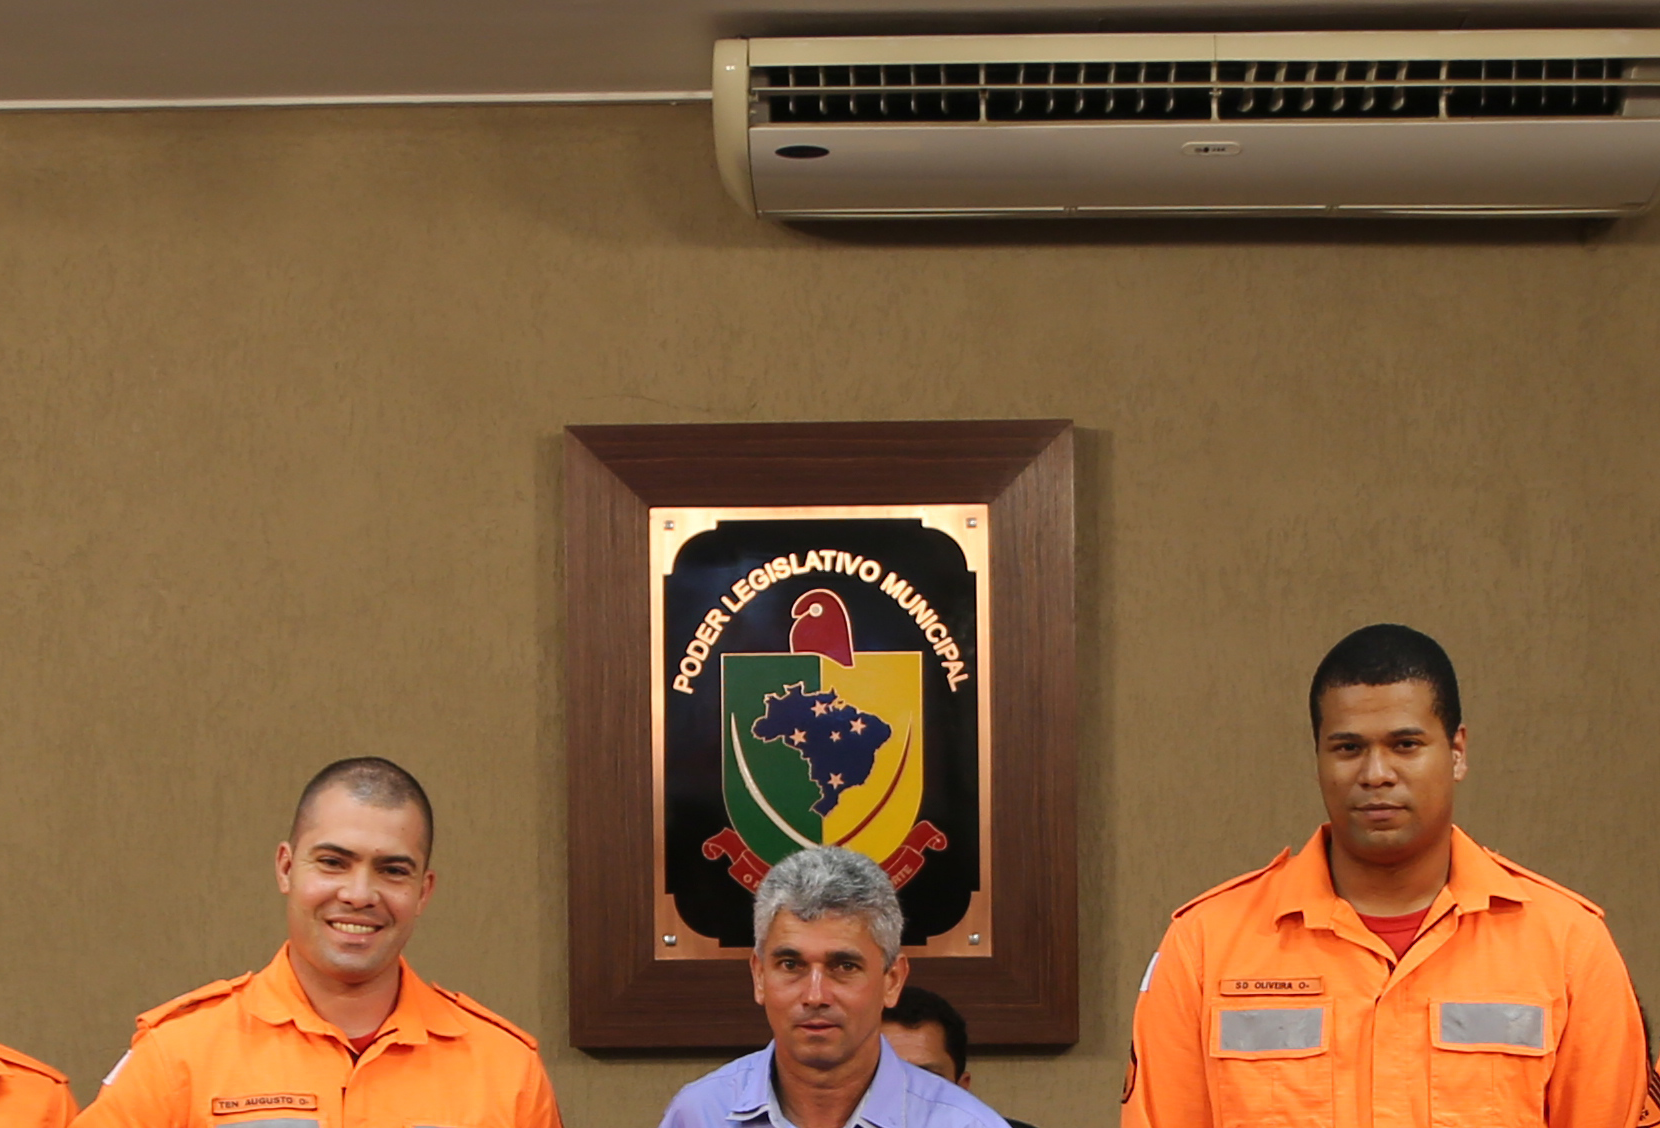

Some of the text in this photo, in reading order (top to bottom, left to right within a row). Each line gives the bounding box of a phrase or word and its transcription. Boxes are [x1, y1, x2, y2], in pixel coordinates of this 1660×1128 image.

[672, 549, 969, 694] PODER LEGISLATIVO MUNICIPAL
[1235, 981, 1249, 990] SD
[1254, 981, 1292, 990] OLIVEIRA
[218, 1100, 239, 1109] TEN
[245, 1096, 293, 1106] AUGUSTO
